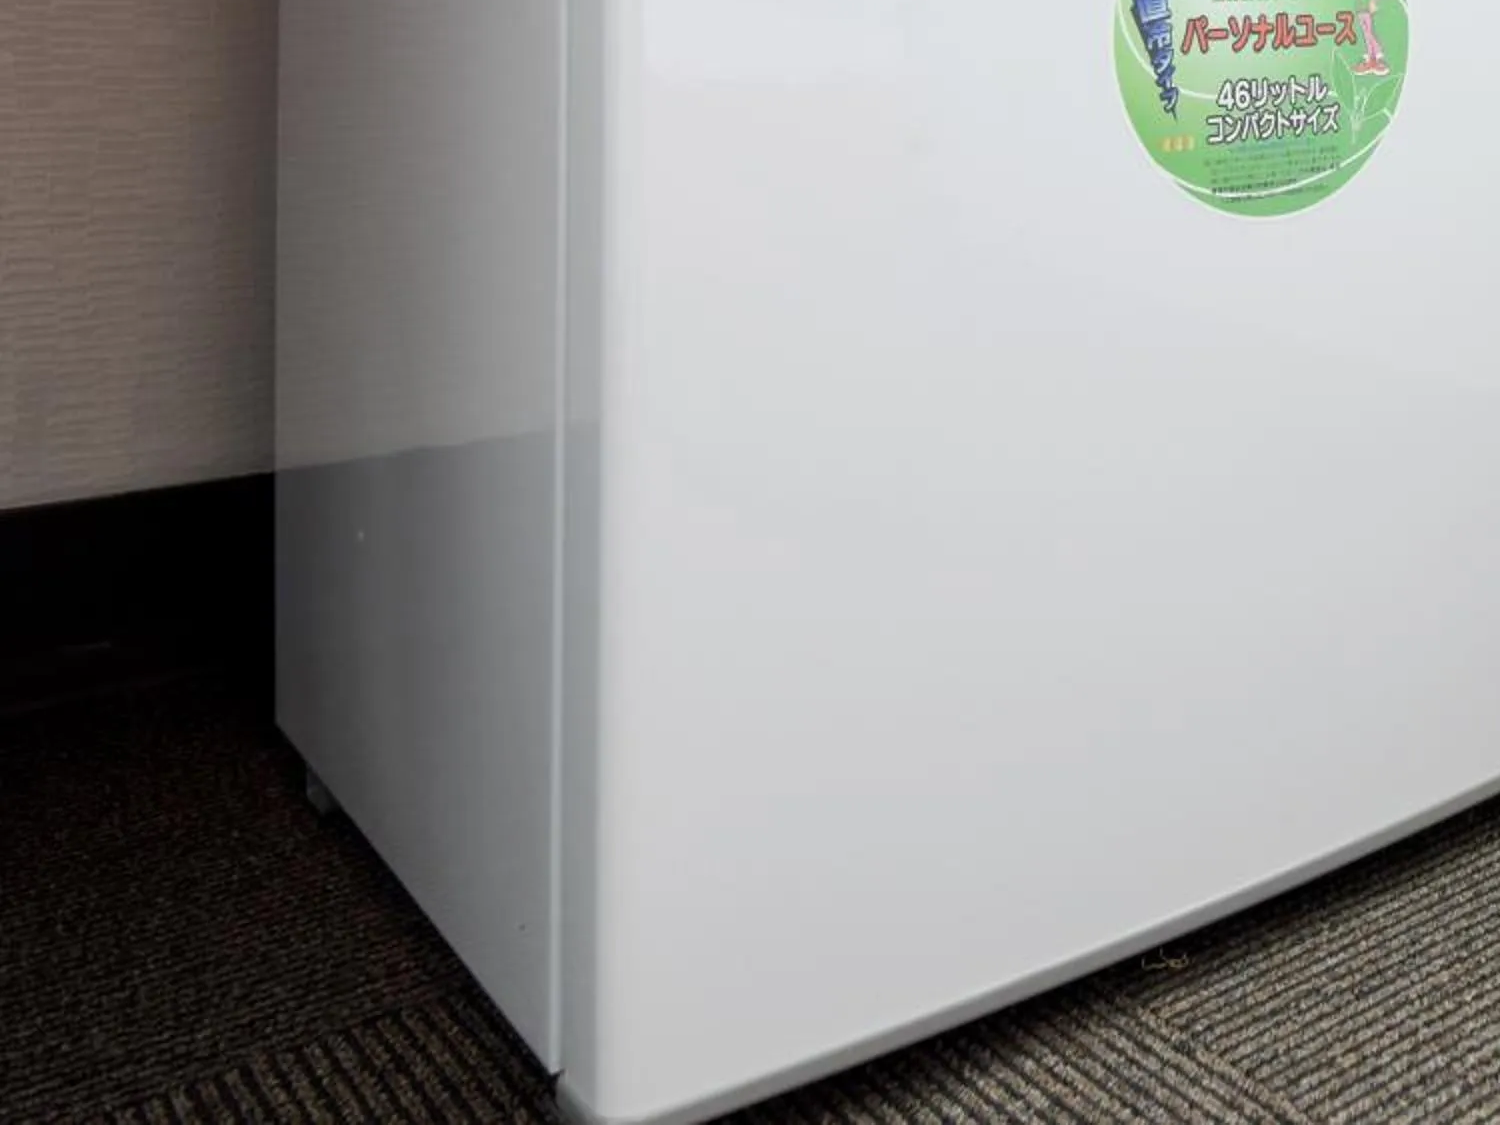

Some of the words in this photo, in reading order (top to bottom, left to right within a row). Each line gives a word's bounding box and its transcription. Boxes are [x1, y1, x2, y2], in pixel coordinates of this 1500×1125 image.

[1217, 74, 1328, 111] 46リットル
[1206, 102, 1341, 146] コンパクトサイズ
